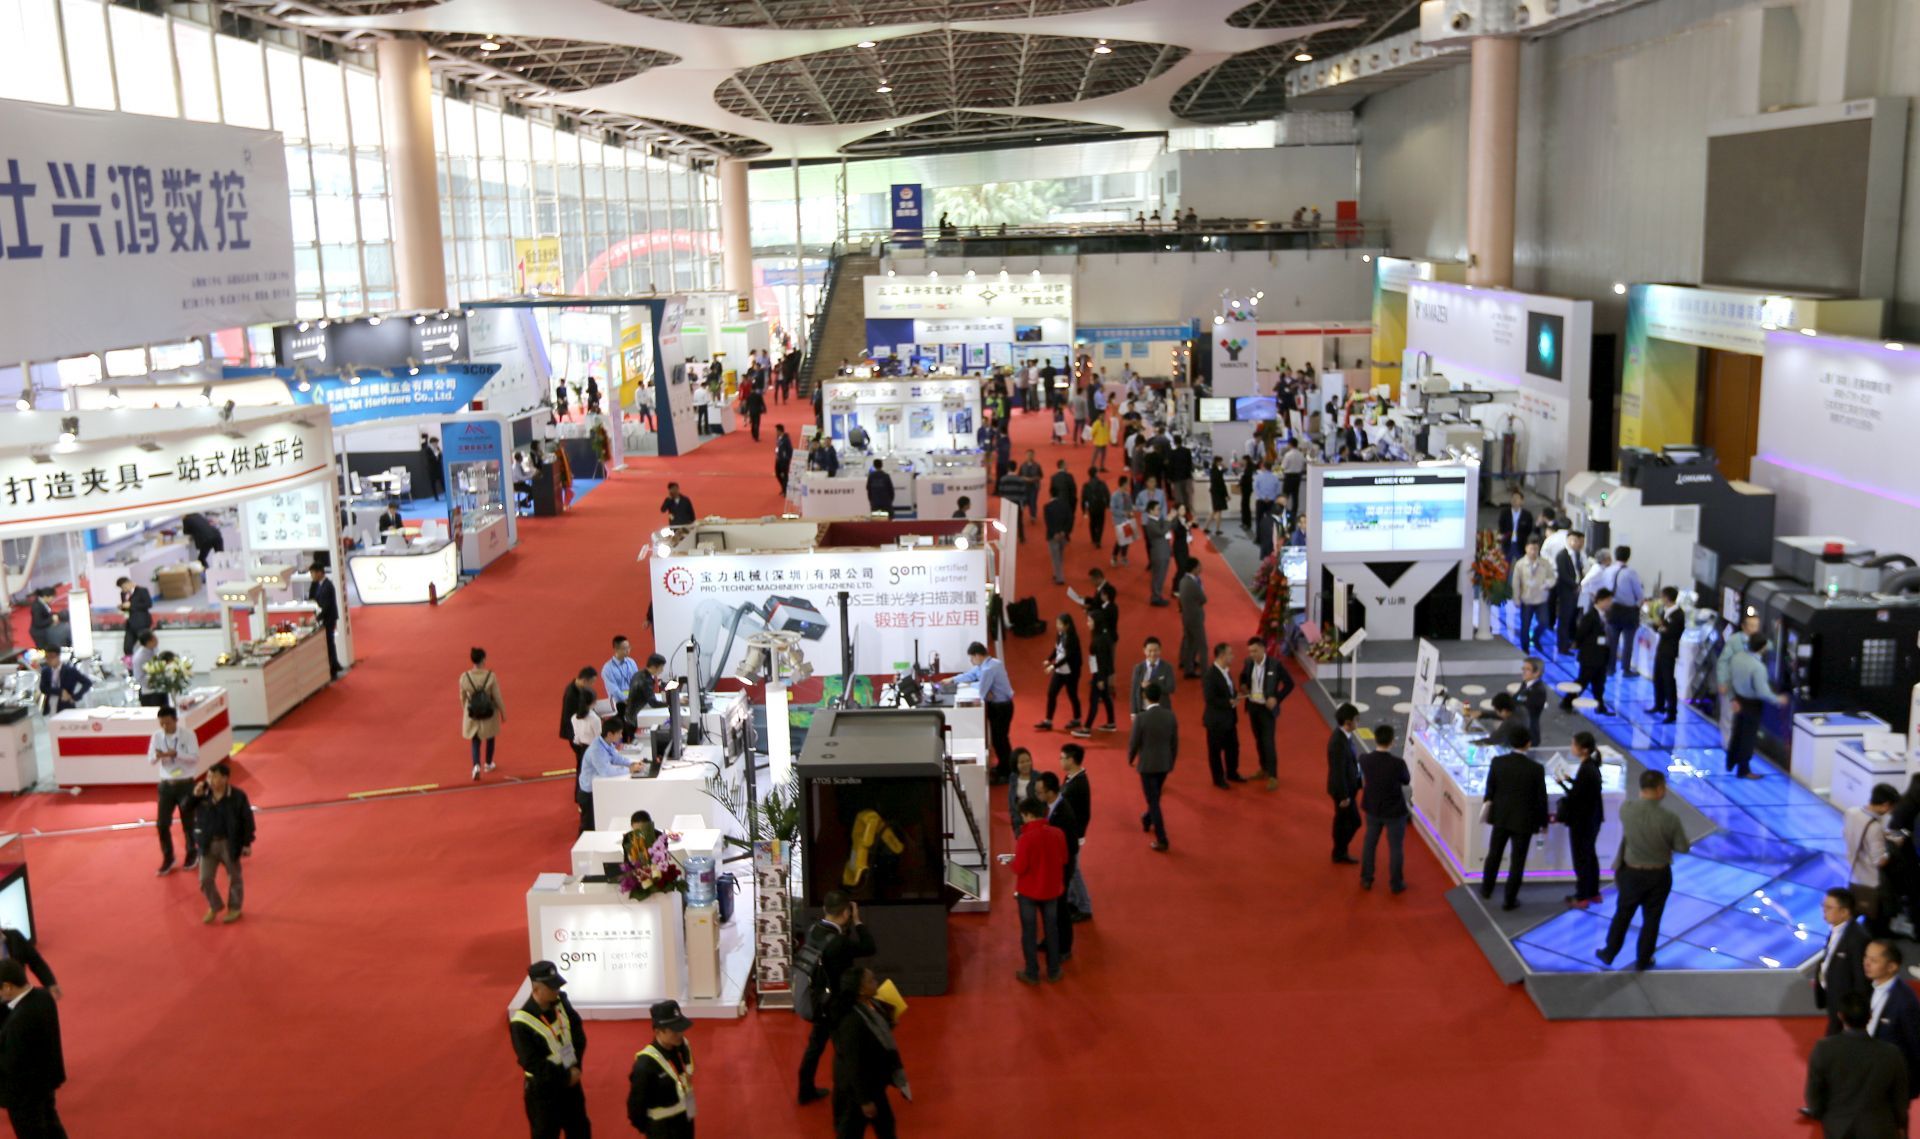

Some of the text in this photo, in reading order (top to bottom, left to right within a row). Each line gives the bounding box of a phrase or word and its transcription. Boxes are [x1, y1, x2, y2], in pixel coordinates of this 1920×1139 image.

[4, 434, 304, 506] 打造夹具一站式供应平台
[934, 563, 968, 572] certified
[889, 565, 926, 585] gom
[934, 574, 967, 583] partner
[757, 583, 804, 592] MACHINERY
[857, 582, 873, 590] LTD.
[874, 610, 979, 628] 锻造行业应用
[610, 951, 648, 960] certified
[560, 952, 597, 971] gom
[611, 961, 648, 970] partner
